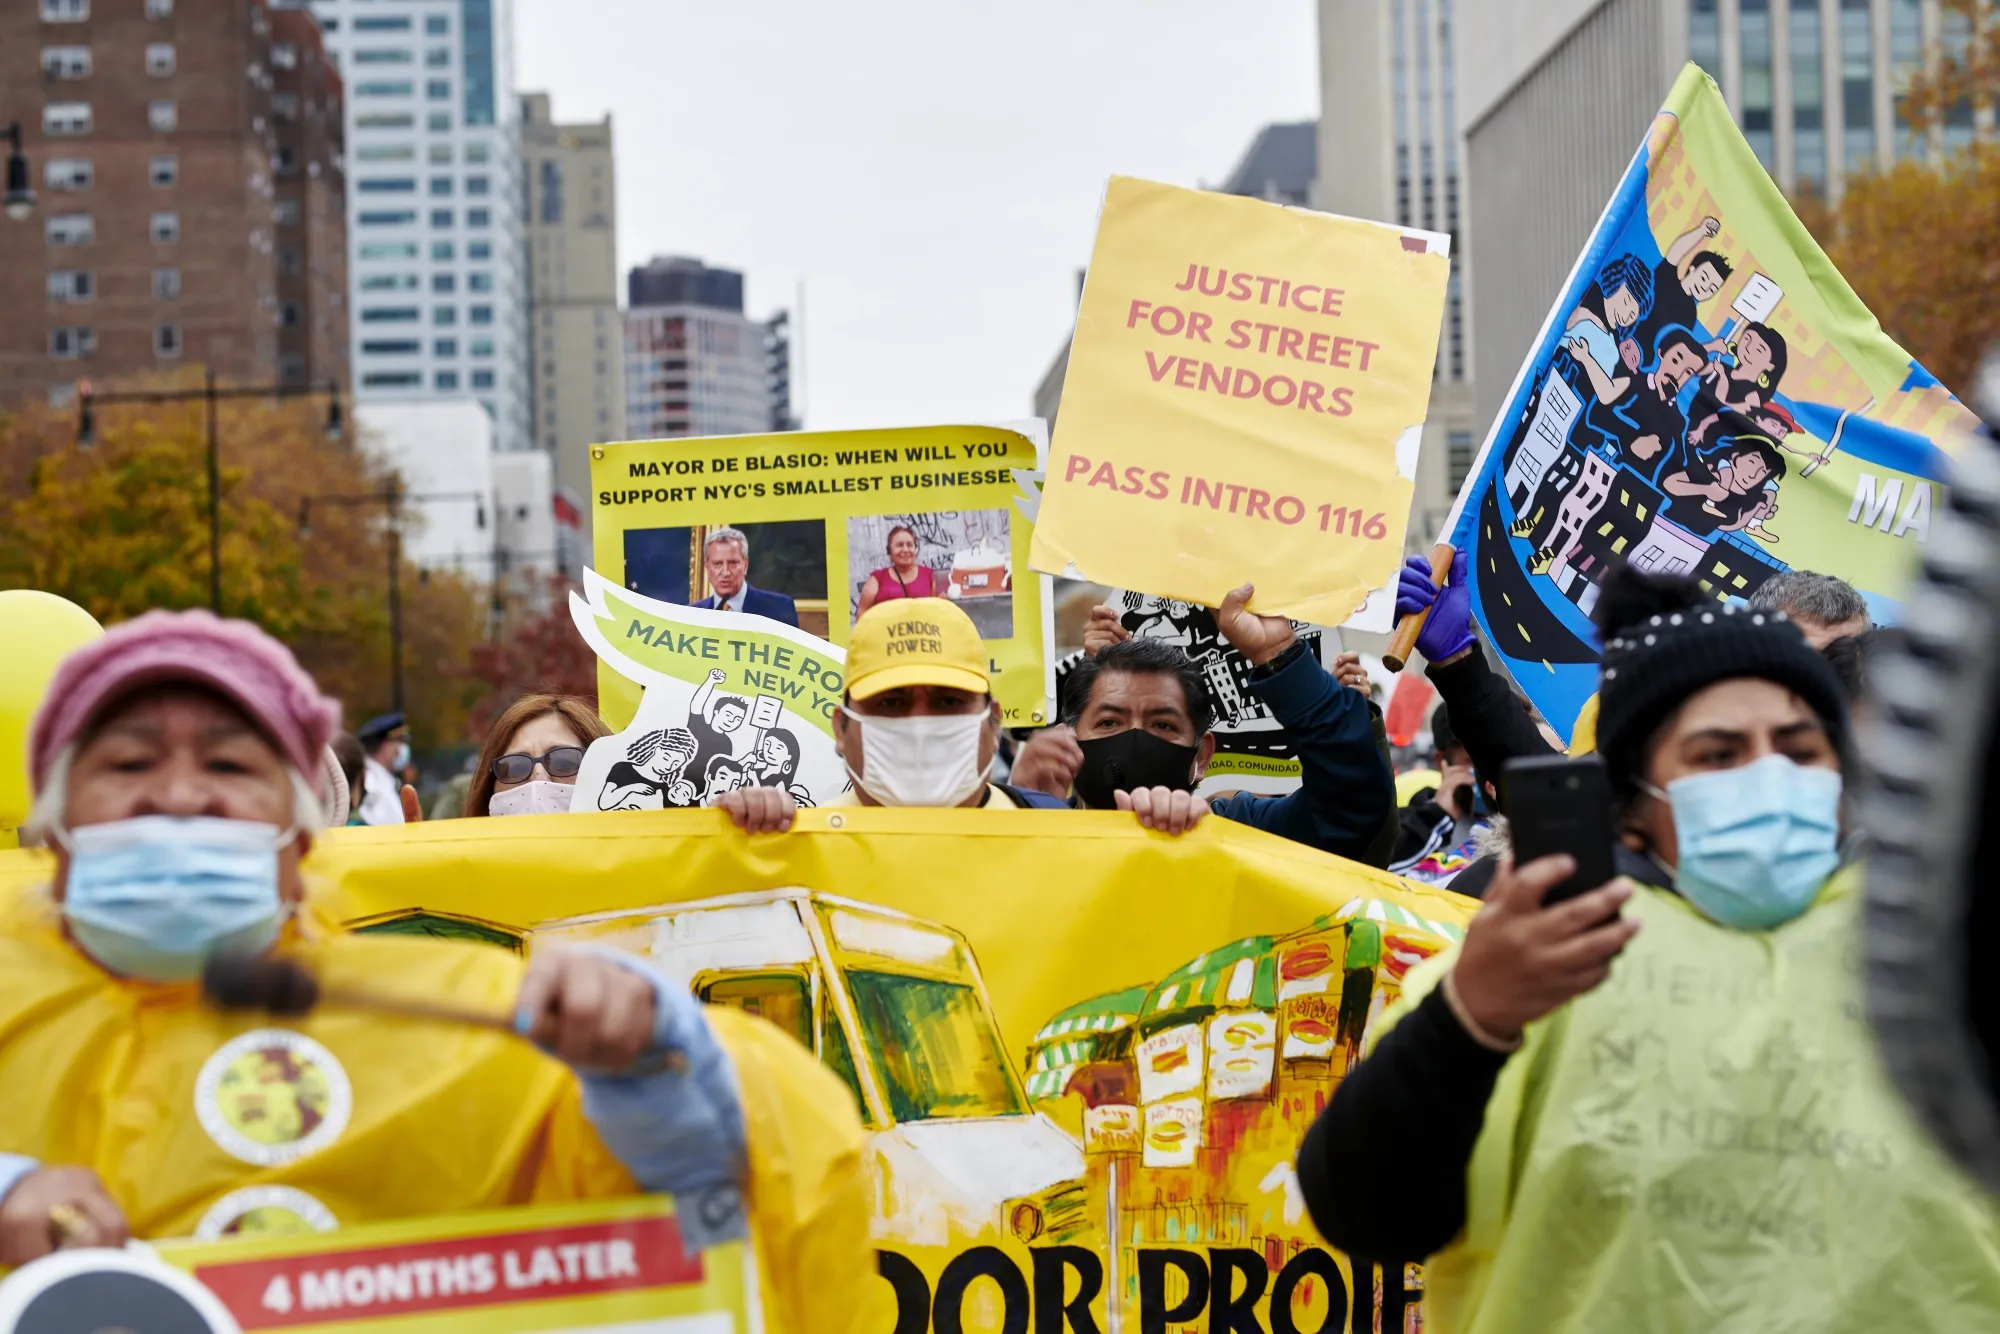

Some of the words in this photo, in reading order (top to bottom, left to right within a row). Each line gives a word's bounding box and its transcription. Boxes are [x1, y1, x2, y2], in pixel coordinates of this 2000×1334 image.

[1174, 263, 1346, 318] JUSTICE
[1126, 299, 1213, 344] FOR
[1225, 319, 1380, 372] STREET
[1144, 350, 1355, 418] VENDORS
[629, 460, 704, 478] MAYOR
[711, 457, 739, 473] DE
[745, 453, 828, 471] BLASIO:
[835, 449, 898, 466] WHEN
[904, 445, 957, 462] WILL
[962, 442, 1008, 458] YOU
[599, 486, 697, 506] SUPPORT
[704, 483, 766, 500] NYC'S
[772, 476, 883, 496] SMALLEST
[890, 468, 1035, 490] BUSINESSE
[1064, 454, 1170, 500] PASS
[1180, 476, 1306, 526] INTRO
[1316, 503, 1388, 541] 1116
[626, 618, 720, 660] MAKE
[727, 640, 794, 671] THE
[886, 639, 942, 656] POWER!
[887, 621, 941, 638] VENDOR
[743, 668, 806, 700] NEW
[810, 690, 844, 719] YO
[1001, 708, 1020, 720] YC
[1238, 760, 1300, 773] COMUNIDAD
[261, 1275, 293, 1314] 4
[301, 1253, 496, 1310] MONTHS
[503, 1239, 639, 1290] LATER
